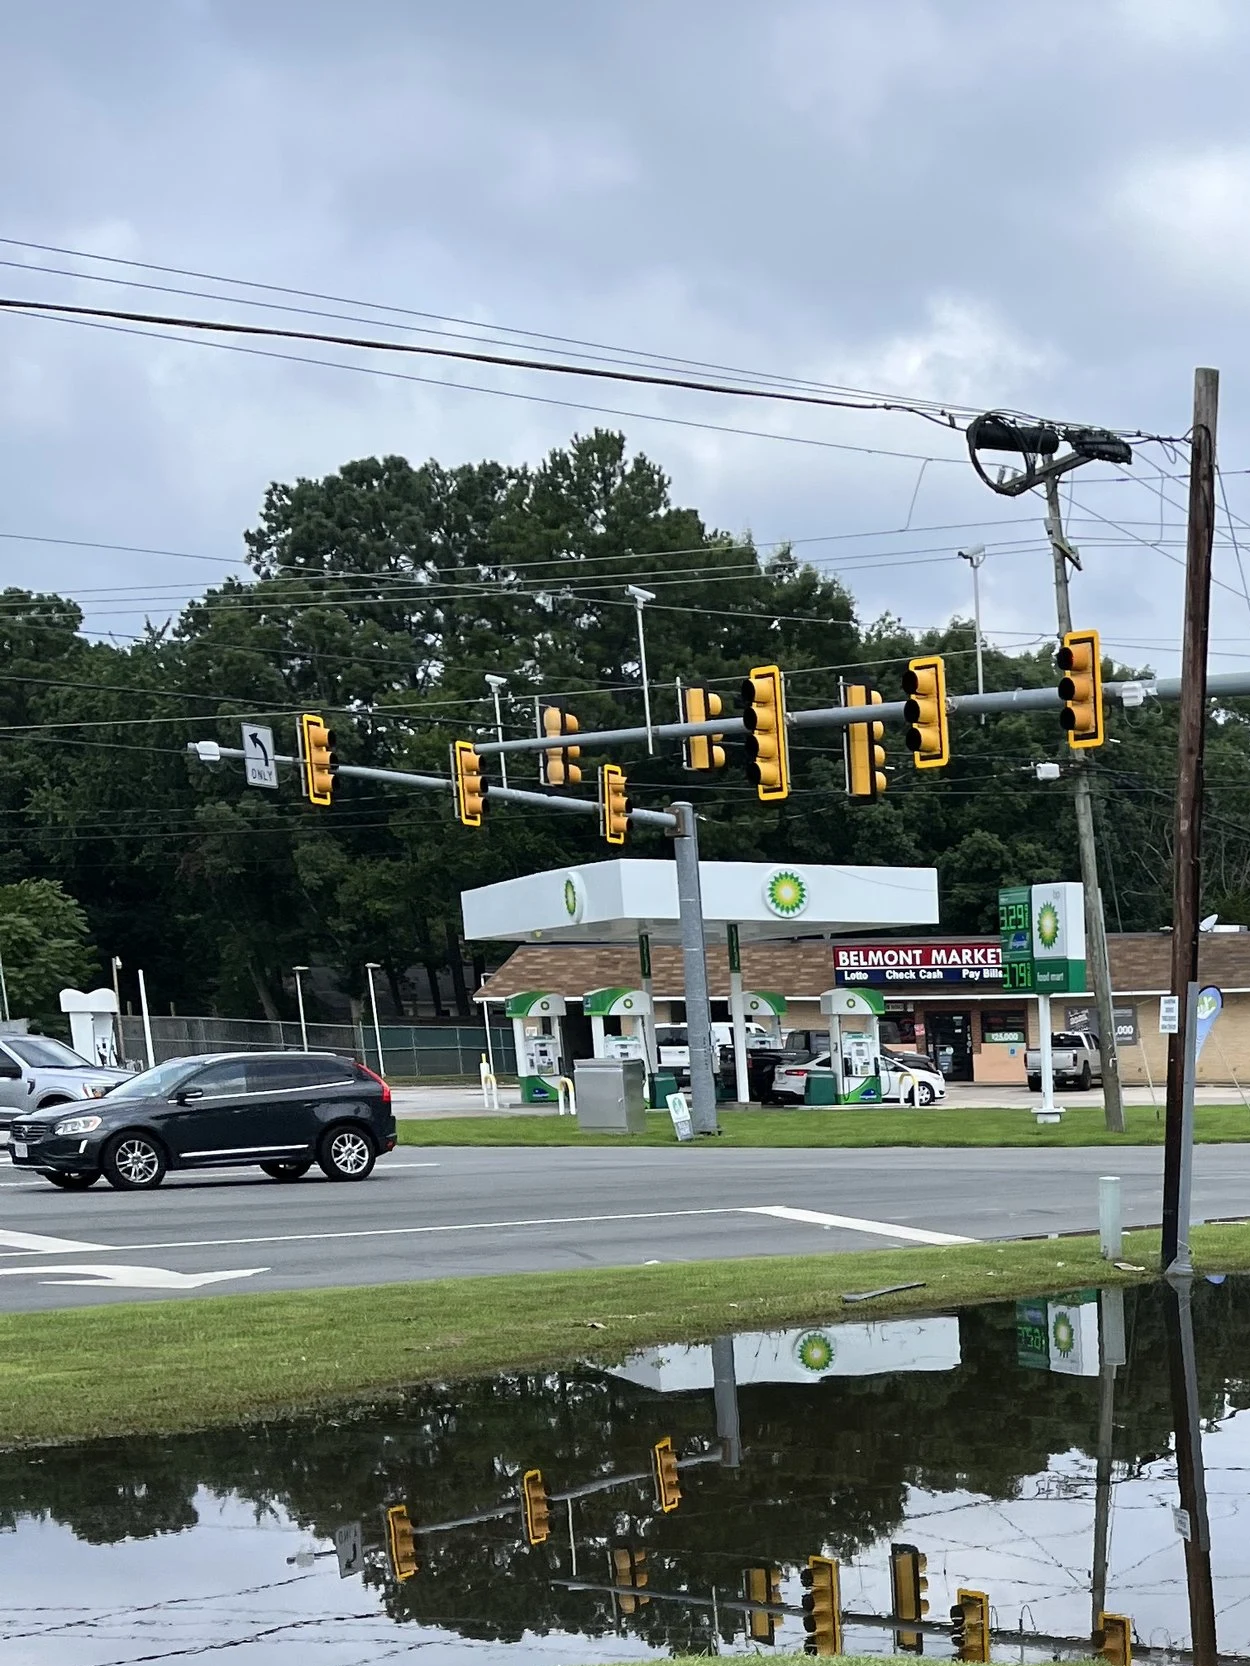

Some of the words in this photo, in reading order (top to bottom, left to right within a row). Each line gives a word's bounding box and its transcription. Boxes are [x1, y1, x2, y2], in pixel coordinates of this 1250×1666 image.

[252, 768, 272, 781] ONLY
[838, 949, 922, 966] BELMONT
[931, 948, 1002, 964] MARKET
[844, 970, 869, 980] Lotto
[885, 970, 916, 980] Check
[919, 969, 943, 979] Cash
[962, 969, 980, 980] Pay
[983, 969, 1003, 978] Bills
[1037, 972, 1049, 981] food
[1051, 972, 1064, 981] mart
